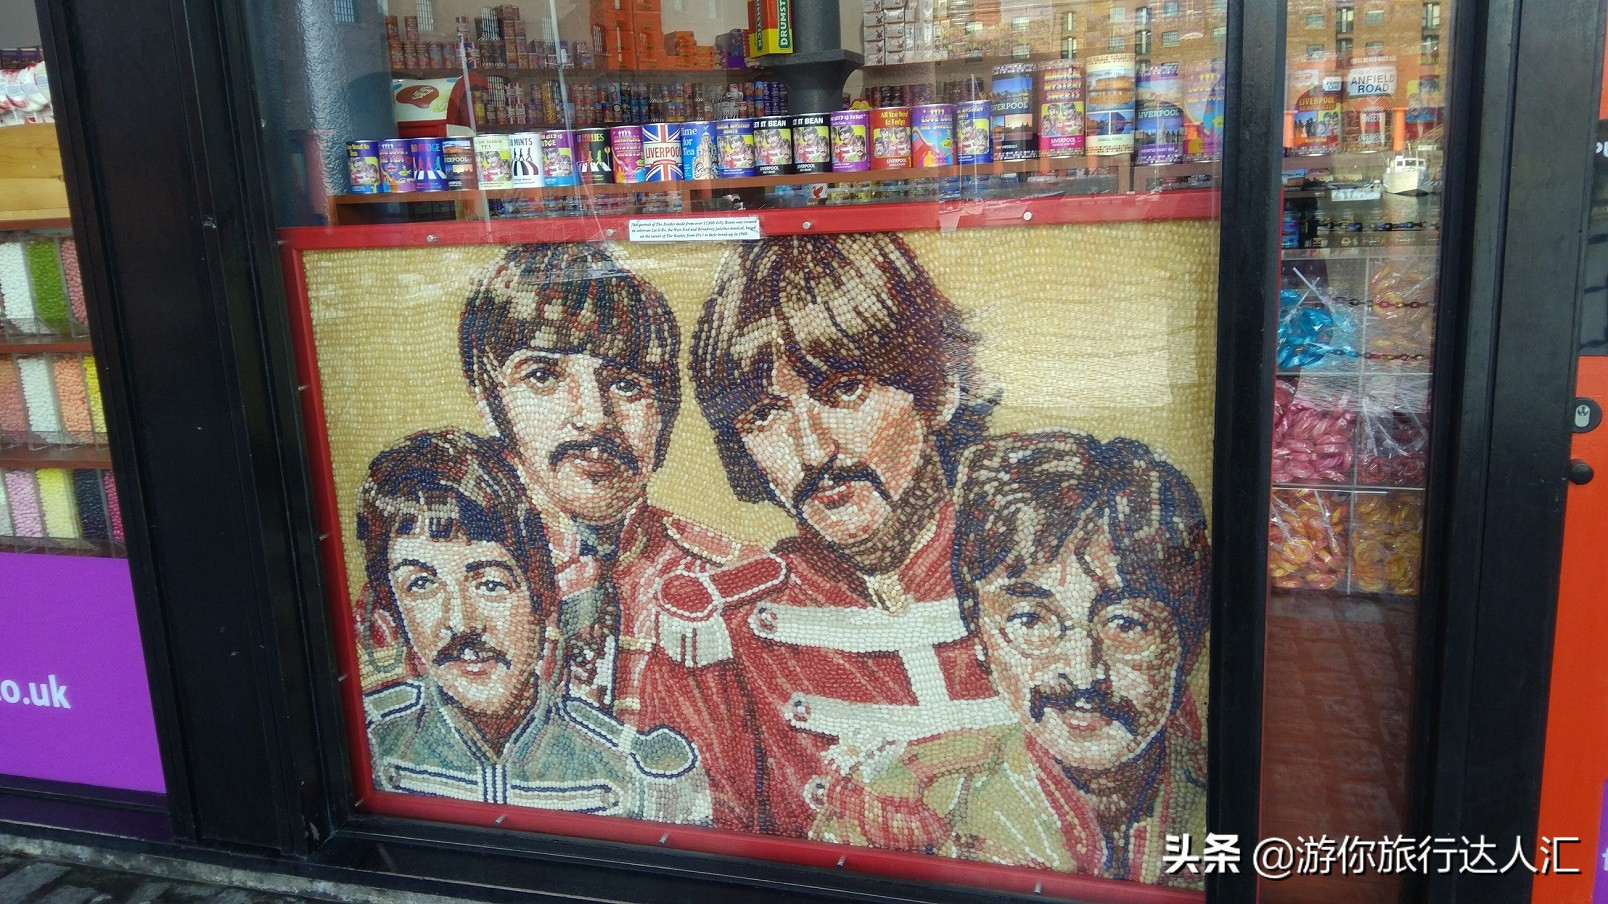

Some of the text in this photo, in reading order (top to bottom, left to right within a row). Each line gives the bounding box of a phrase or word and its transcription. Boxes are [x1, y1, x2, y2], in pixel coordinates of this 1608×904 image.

[780, 0, 789, 46] DRUMST
[1351, 74, 1395, 86] ANFIELD
[1357, 83, 1389, 94] ROAD
[1138, 108, 1180, 118] LIVERPOOL
[767, 120, 787, 128] BEAN
[804, 117, 824, 125] BEAN
[0, 674, 72, 709] o.uk
